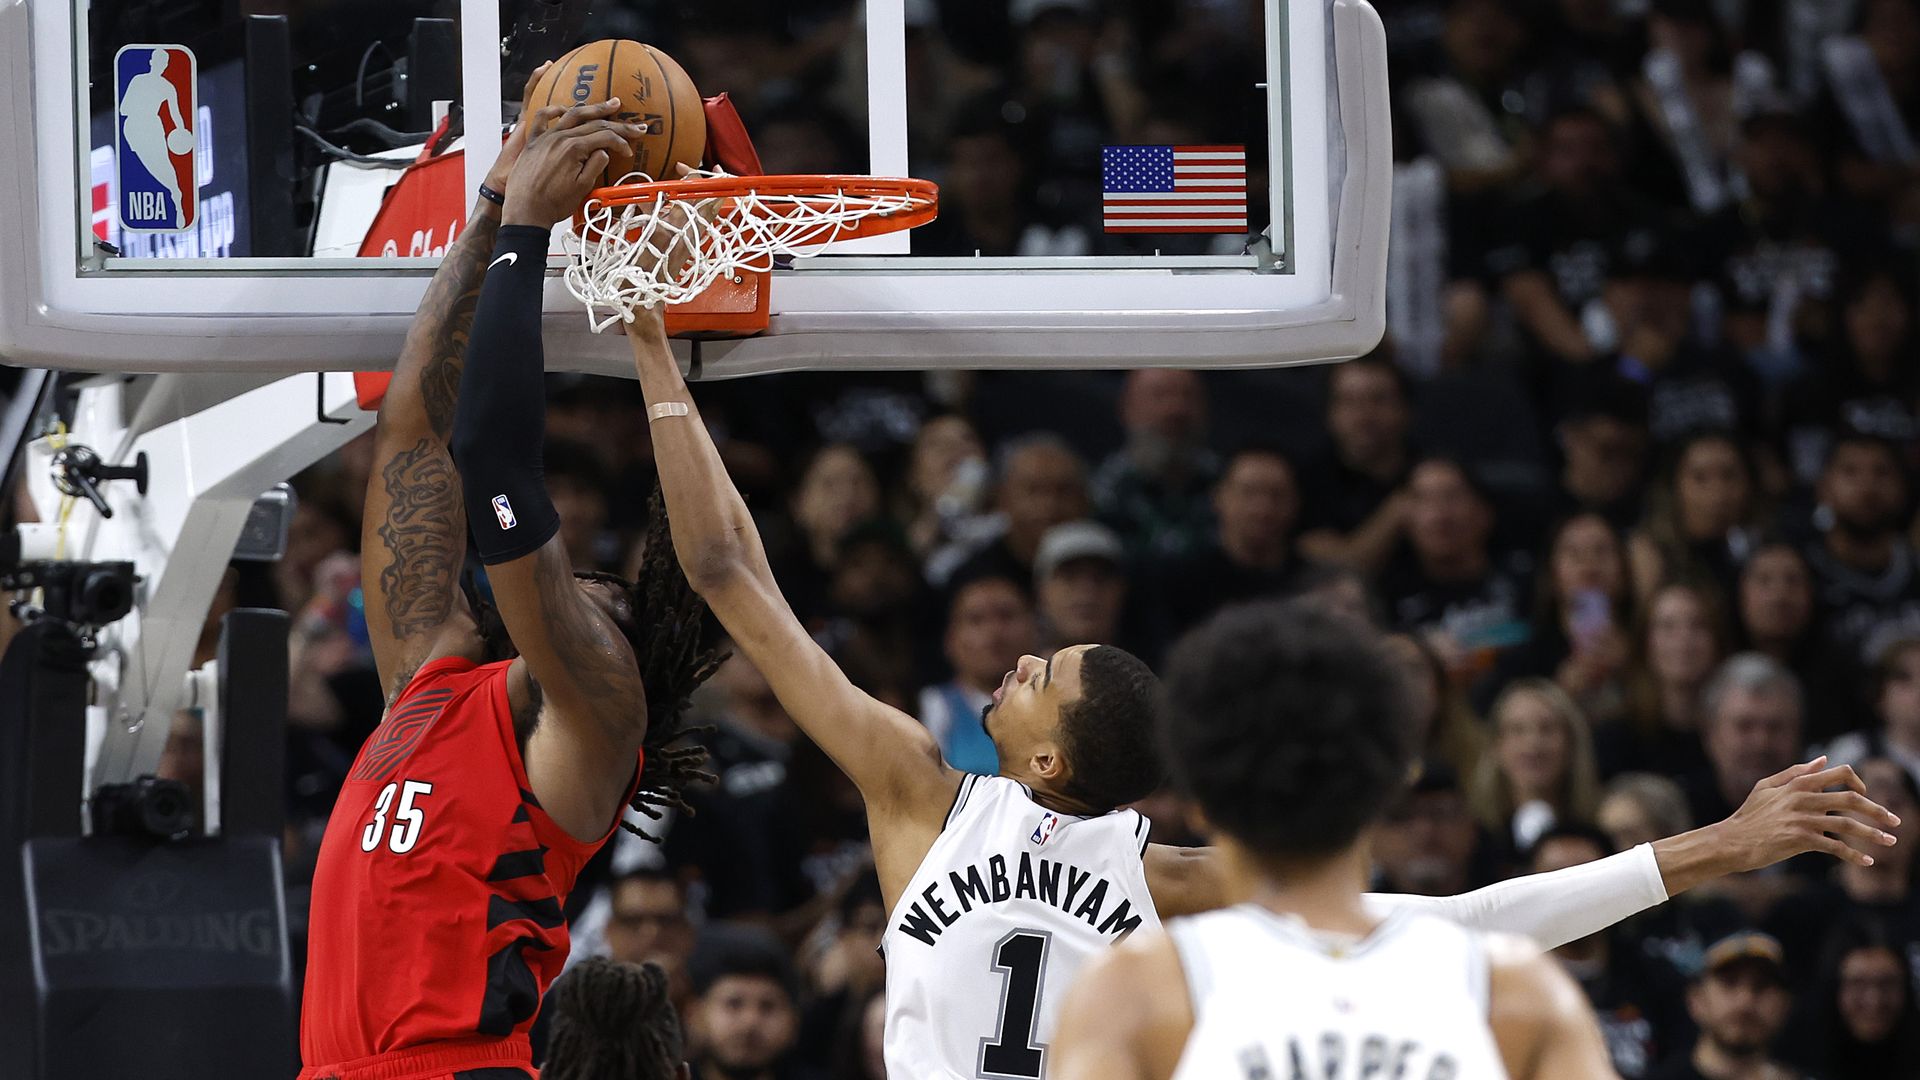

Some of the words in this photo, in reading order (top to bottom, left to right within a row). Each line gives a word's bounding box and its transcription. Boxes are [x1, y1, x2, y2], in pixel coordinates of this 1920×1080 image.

[129, 191, 167, 220] NBA
[361, 779, 433, 854] 35
[43, 909, 271, 956] SPALDING
[898, 851, 1143, 947] WEMBANYAM
[976, 927, 1052, 1080] 1
